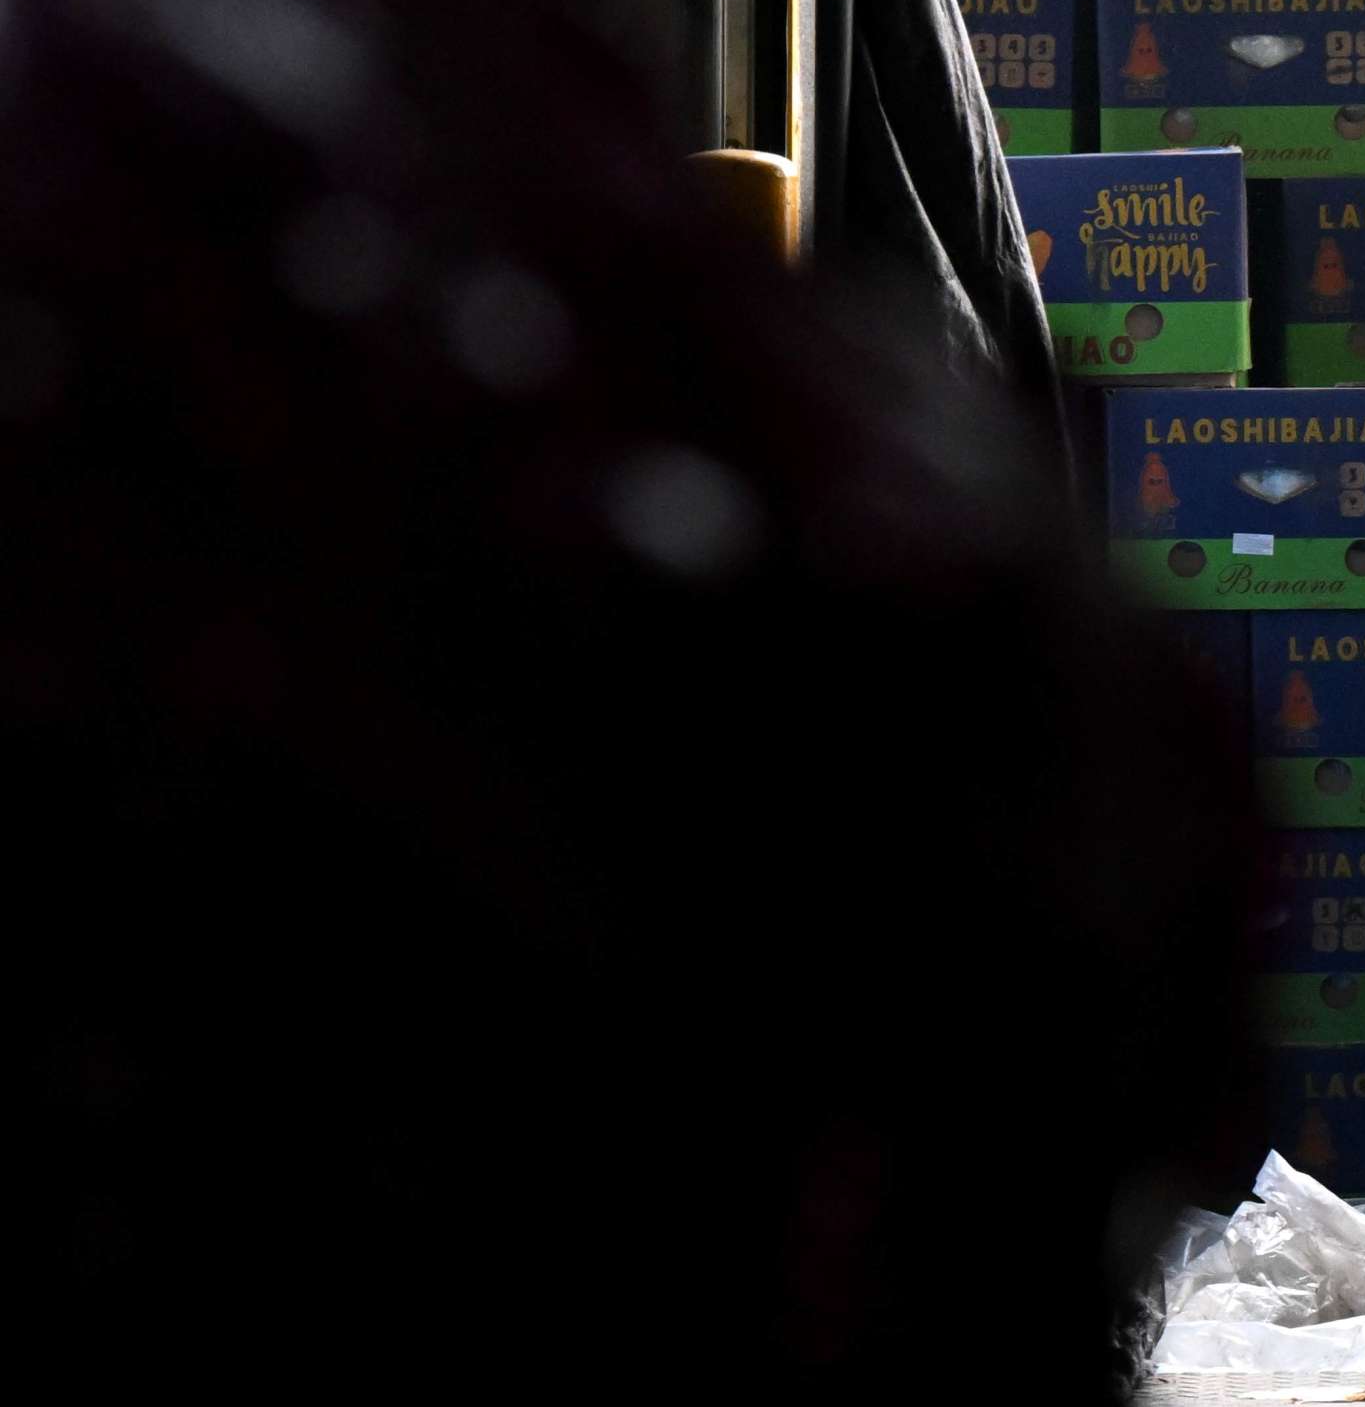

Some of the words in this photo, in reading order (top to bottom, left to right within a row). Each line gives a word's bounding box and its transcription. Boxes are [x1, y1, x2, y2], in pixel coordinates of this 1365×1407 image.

[1083, 176, 1220, 241] smile
[1080, 222, 1218, 292] happy
[1148, 233, 1198, 241] BAJIAO
[1217, 564, 1346, 595] Banana
